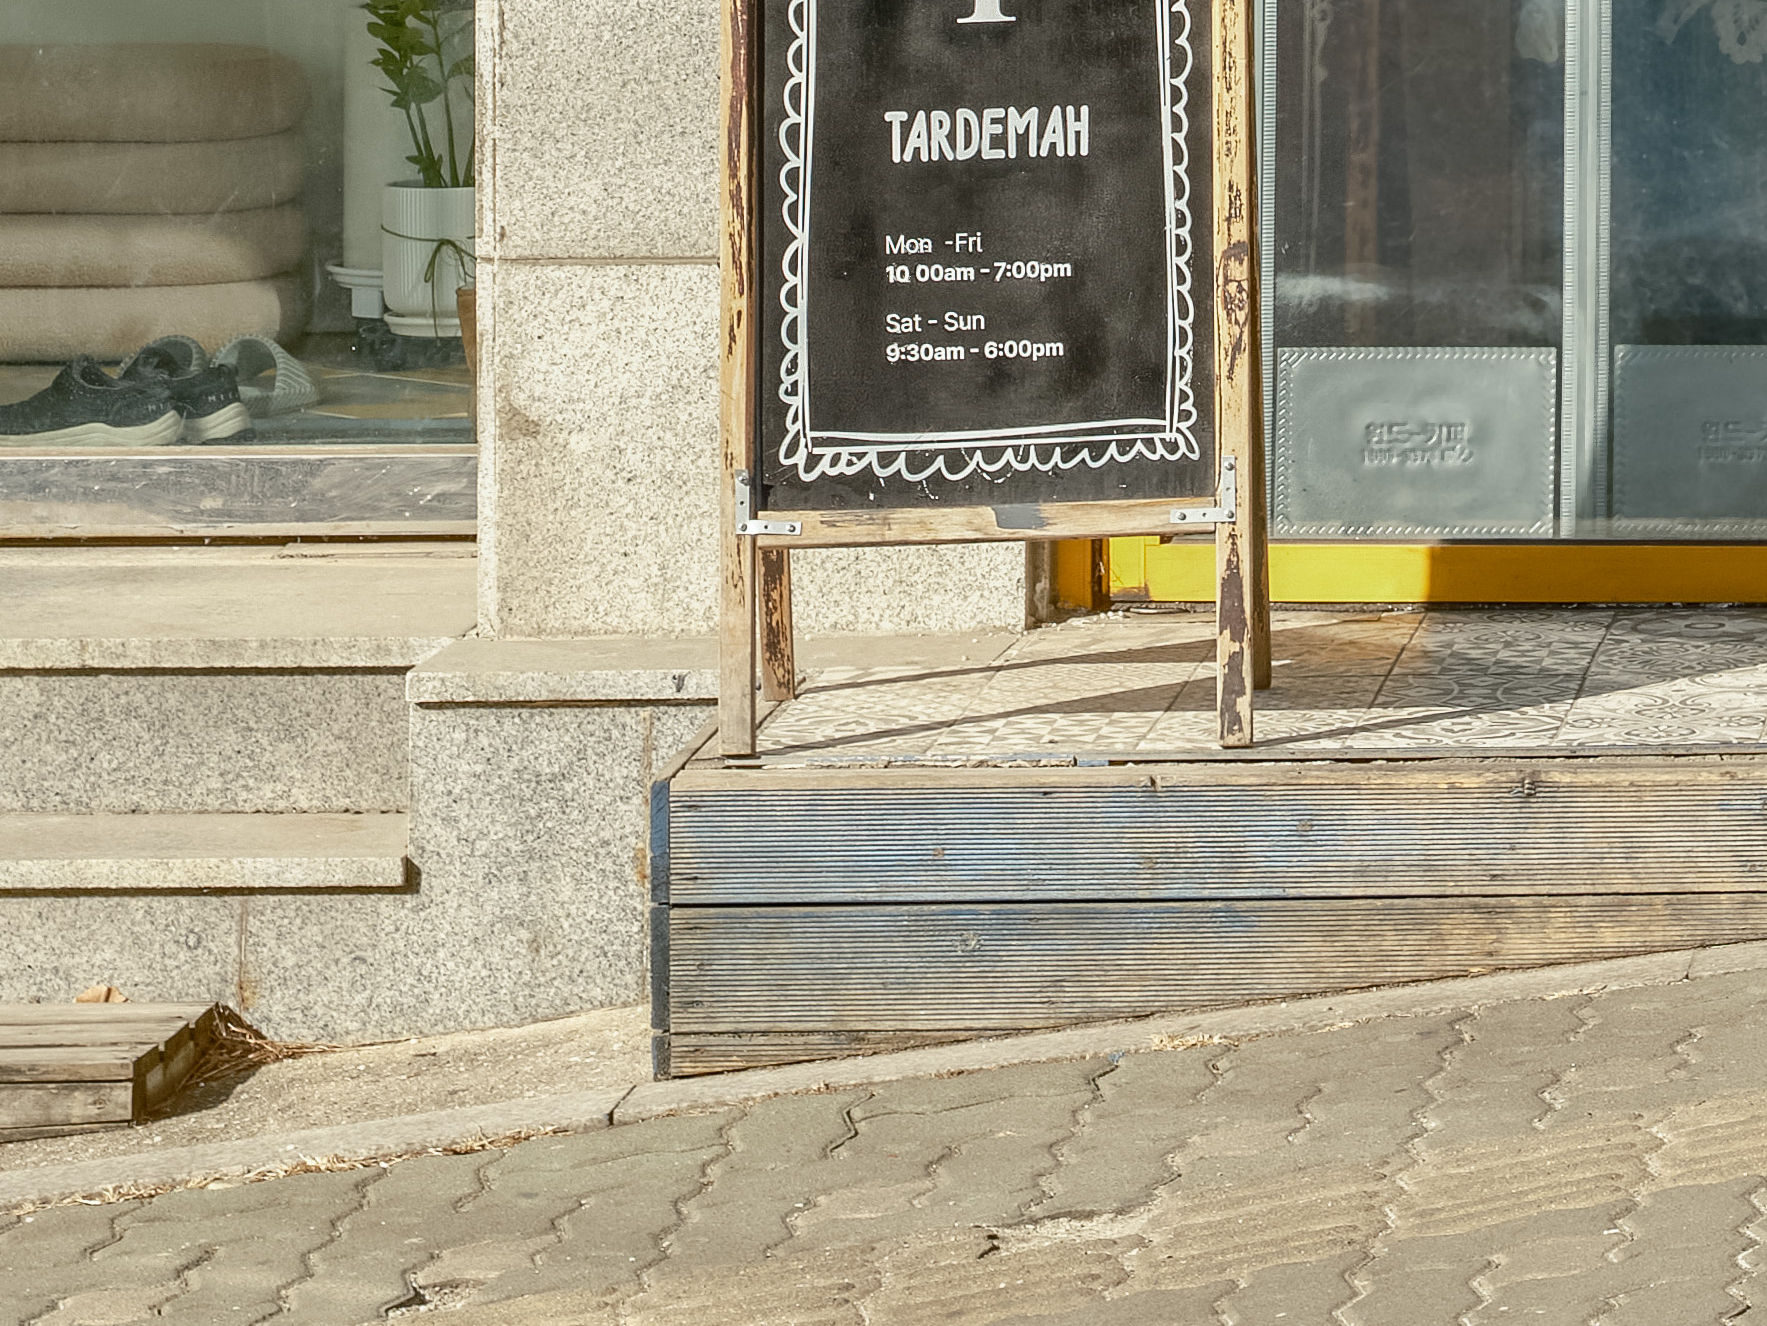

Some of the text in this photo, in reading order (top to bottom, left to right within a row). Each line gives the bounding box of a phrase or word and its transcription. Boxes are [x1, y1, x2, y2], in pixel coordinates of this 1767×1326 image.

[883, 104, 1090, 164] TARDEMAH
[885, 234, 932, 255] Mon
[993, 260, 1072, 282] 7:00pm
[885, 313, 922, 334] Sat
[943, 311, 986, 332] Sun
[885, 342, 965, 363] 9:30am
[983, 339, 1064, 362] 6:00pm
